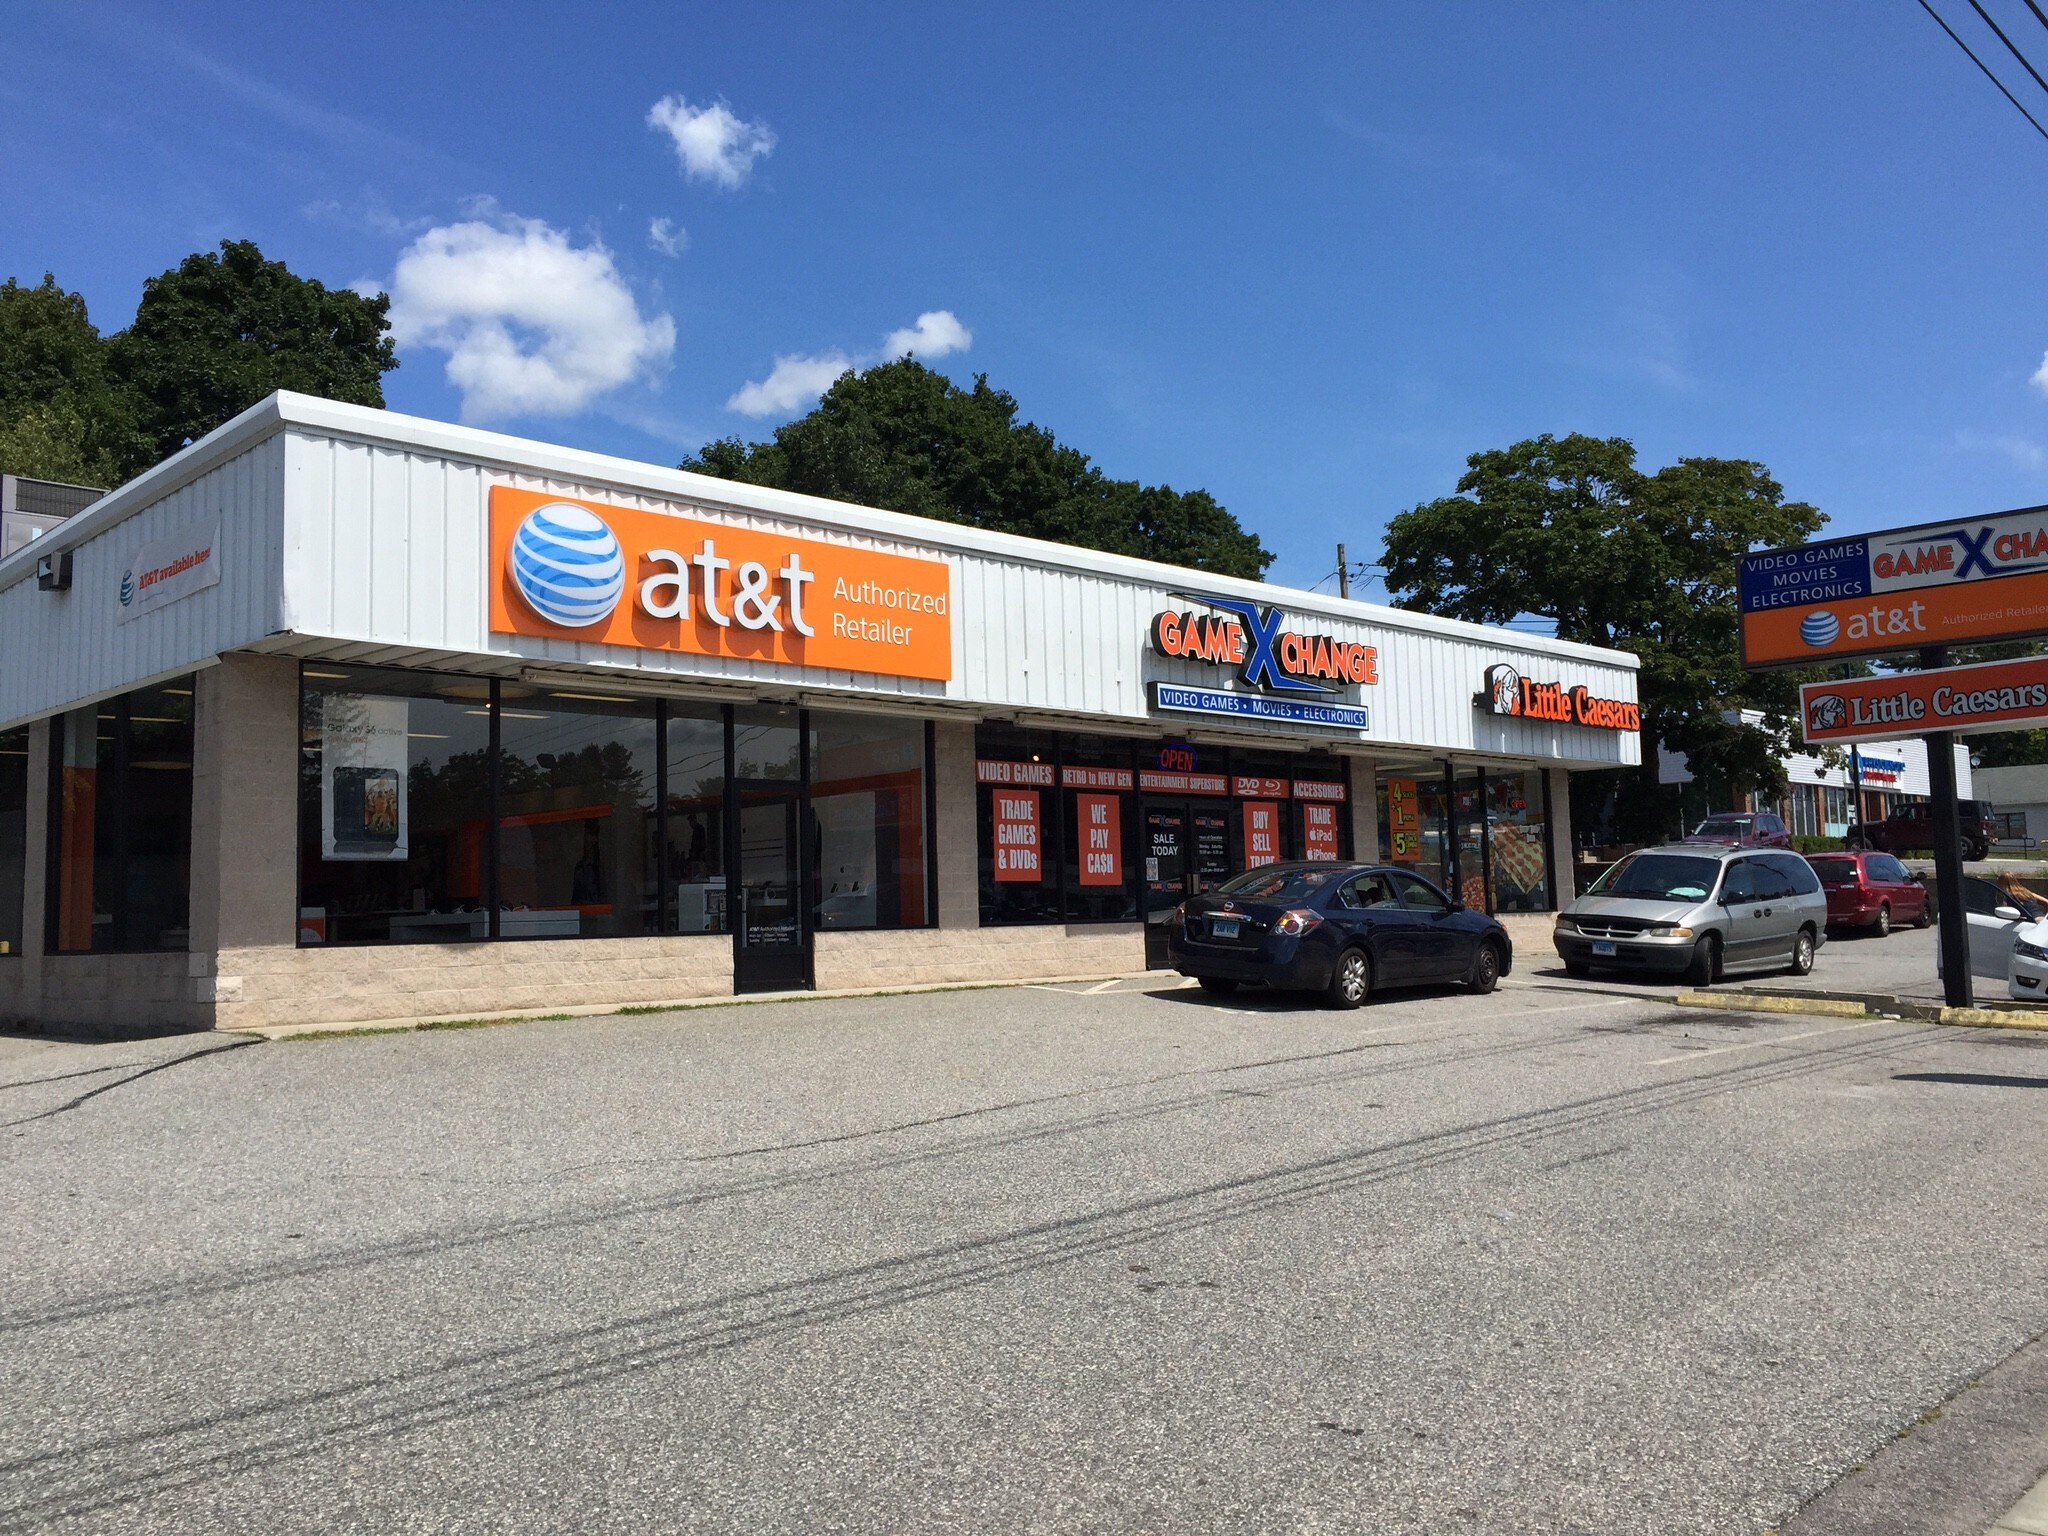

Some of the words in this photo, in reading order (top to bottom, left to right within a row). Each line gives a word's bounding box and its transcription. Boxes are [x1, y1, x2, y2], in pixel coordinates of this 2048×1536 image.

[1747, 554, 1798, 572] VIDEO
[1804, 543, 1864, 563] GAMES
[138, 568, 159, 590] AT&T
[160, 553, 194, 580] available
[1773, 567, 1838, 587] MOVIES
[640, 539, 815, 638] at&t
[833, 576, 946, 616] Authorized
[1752, 581, 1862, 608] ELECTRONICS
[833, 613, 913, 645] Retailer
[1847, 600, 1926, 639] at&t
[1942, 610, 2003, 625] Authorized
[1163, 691, 1198, 706] VIDEO
[1201, 695, 1240, 711] GAMES
[1252, 701, 1292, 716] MOVIES
[1303, 708, 1364, 725] ELECTRONICS
[1520, 676, 1572, 722] Little
[1575, 685, 1641, 731] Caesars
[1850, 690, 1927, 726] Little
[1932, 682, 2048, 718] Caesars
[1160, 748, 1193, 772] OPEN
[977, 761, 1010, 781] VIDEO
[1013, 763, 1052, 784] GAMES
[1062, 769, 1087, 785] RETRO
[1089, 771, 1096, 785] to
[1098, 771, 1115, 786] NEW
[1117, 772, 1132, 787] GEN
[1139, 773, 1188, 790] ENTERTAINMENT
[1189, 777, 1225, 792] SUPERSTORE
[1238, 778, 1260, 790] DVD
[1293, 782, 1344, 799] ACCESSORIES
[1393, 782, 1403, 803] 4
[1000, 799, 1034, 820] TRADE
[1090, 804, 1107, 824] WE
[1252, 811, 1269, 829] BUY
[1308, 807, 1332, 825] TRADE
[998, 824, 1036, 845] GAMES
[1090, 828, 1109, 849] PAY
[1153, 833, 1175, 844] SALE
[1252, 833, 1271, 852] SELL
[1316, 829, 1332, 841] iPad
[998, 848, 1007, 869] &
[1010, 849, 1037, 869] DVDs
[1151, 846, 1179, 856] TODAY
[1313, 849, 1337, 860] iPhone
